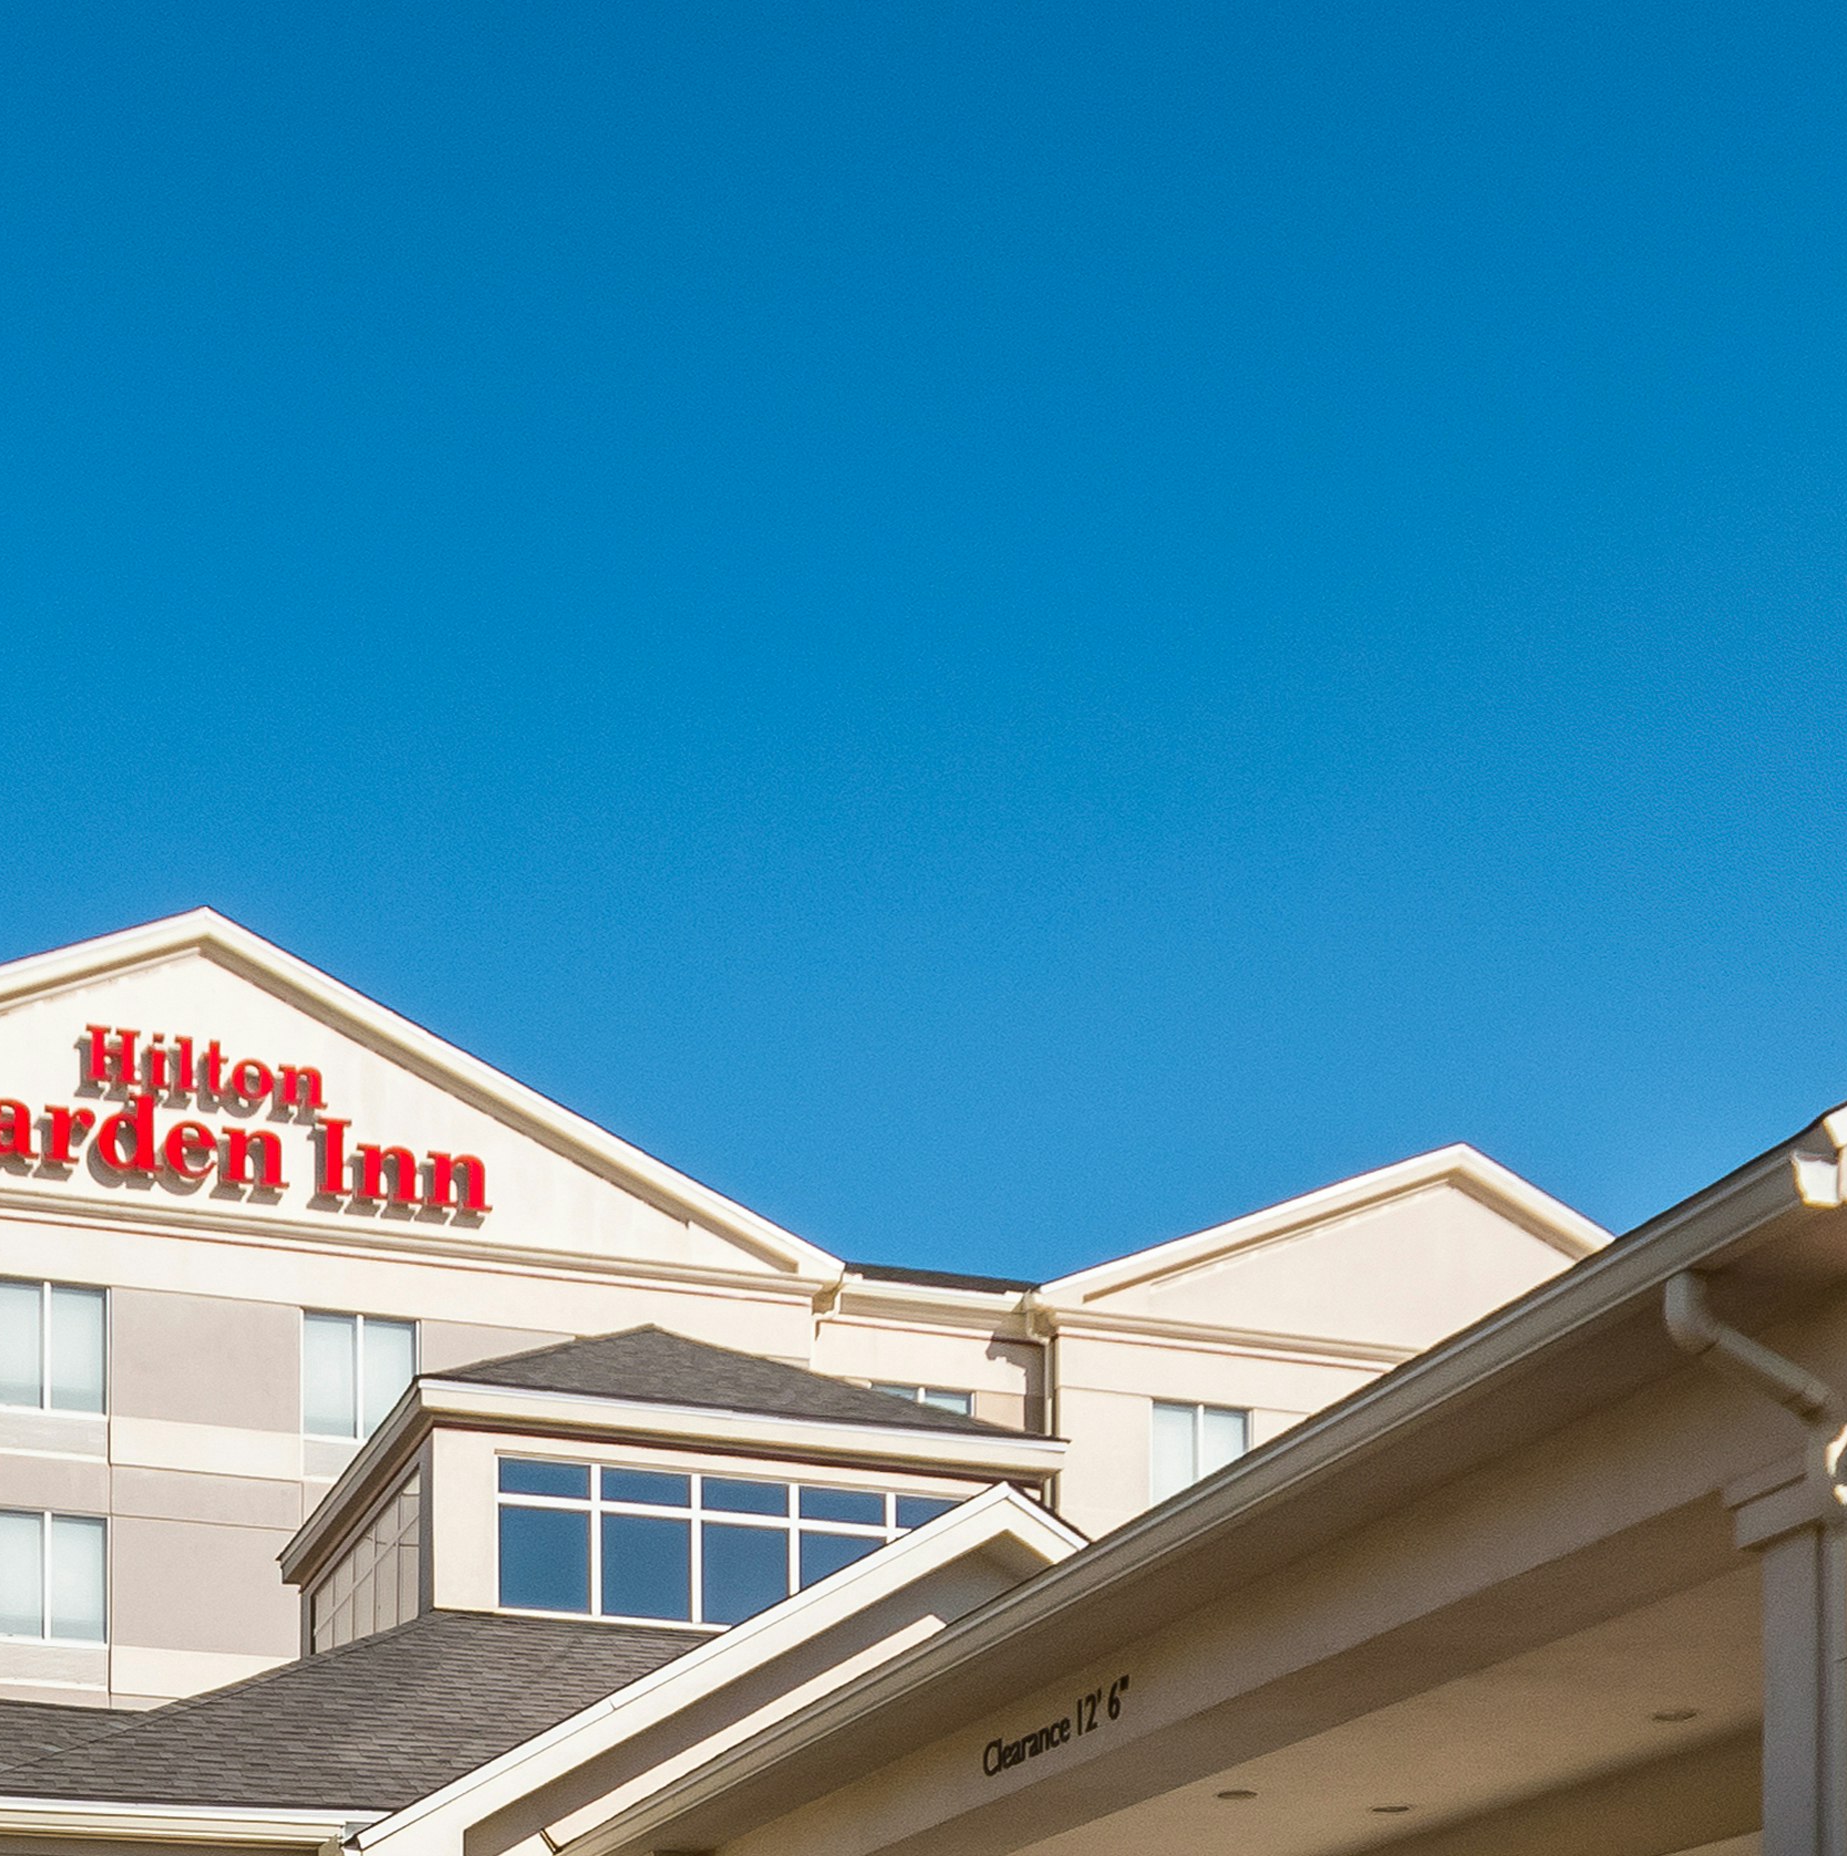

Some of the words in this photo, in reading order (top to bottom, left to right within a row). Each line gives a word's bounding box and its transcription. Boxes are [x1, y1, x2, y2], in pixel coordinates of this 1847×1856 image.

[84, 1024, 327, 1110] Hilton
[315, 1117, 493, 1213] Inn
[982, 1716, 1072, 1777] Clearance
[1077, 1687, 1103, 1737] 12'
